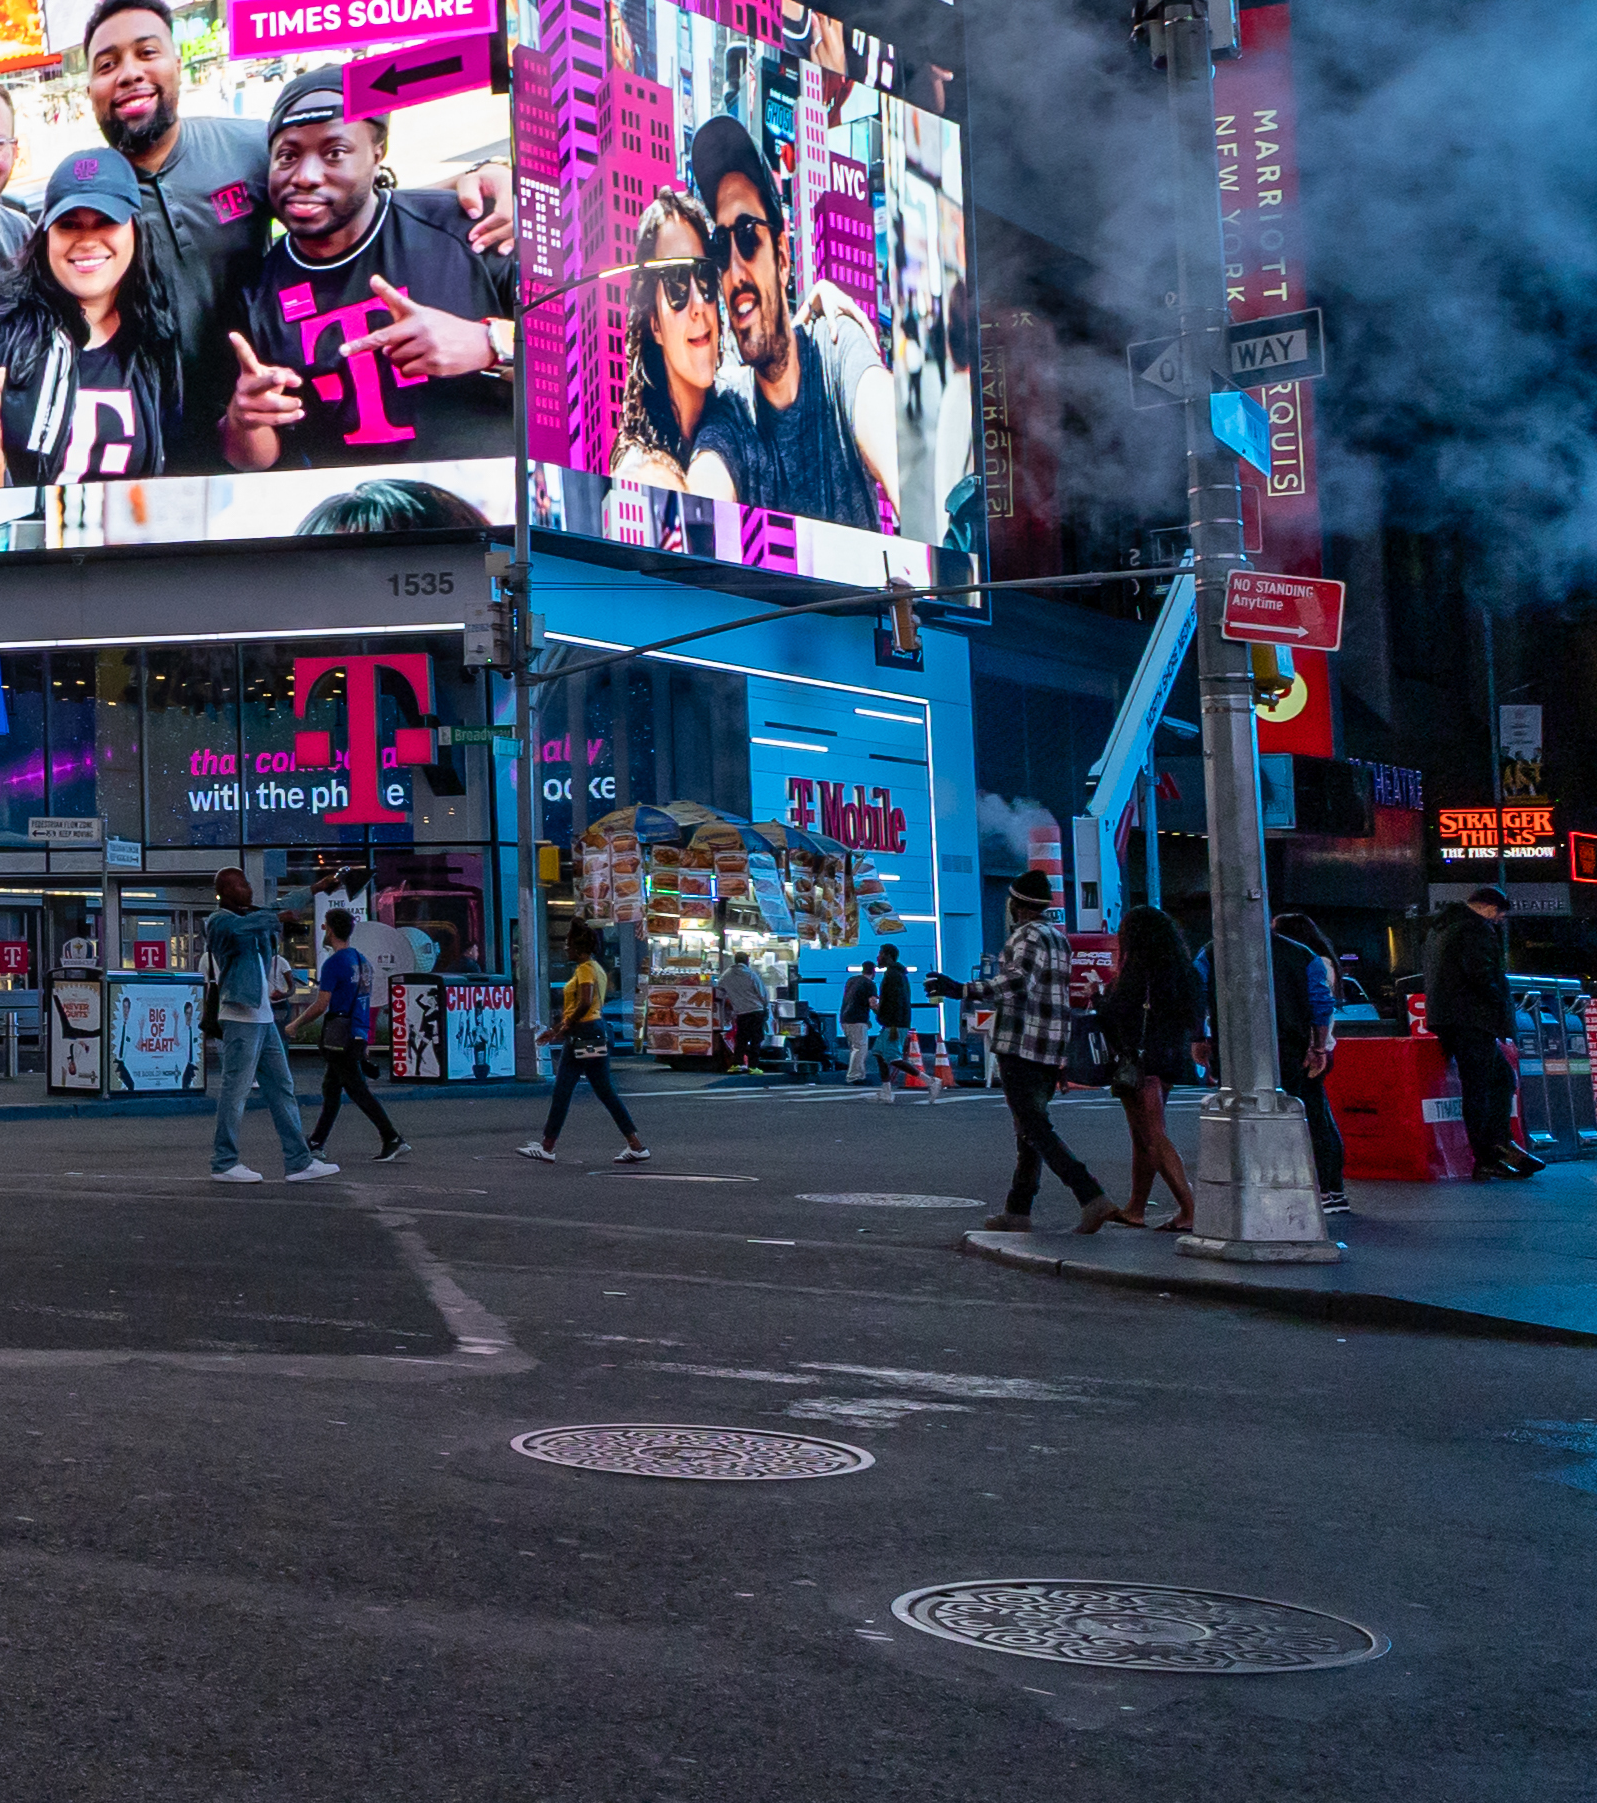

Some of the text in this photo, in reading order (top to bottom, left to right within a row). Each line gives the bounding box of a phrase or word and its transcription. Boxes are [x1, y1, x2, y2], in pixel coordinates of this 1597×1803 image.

[250, 4, 342, 39] TIMES
[831, 161, 866, 201] NYC
[1253, 109, 1288, 302] MARRIOTT
[1237, 334, 1294, 369] WAY
[1268, 383, 1299, 491] RQUIS
[387, 572, 455, 599] 1535
[1233, 578, 1315, 598] NO STANDING
[1231, 593, 1284, 611] Anytime
[294, 653, 434, 824] T
[189, 749, 250, 776] tha
[188, 782, 250, 812] with
[256, 781, 305, 810] the
[311, 779, 405, 815] phe
[819, 781, 908, 854] Mobile
[1440, 847, 1465, 859] THE
[1503, 847, 1555, 858] SHADOW
[1509, 900, 1565, 911] HEATRE
[446, 985, 514, 1012] CHICAGO
[148, 1008, 166, 1022] BIG
[150, 1023, 166, 1037] OF
[391, 984, 408, 1077] CHICAGO
[140, 1038, 175, 1053] HEART
